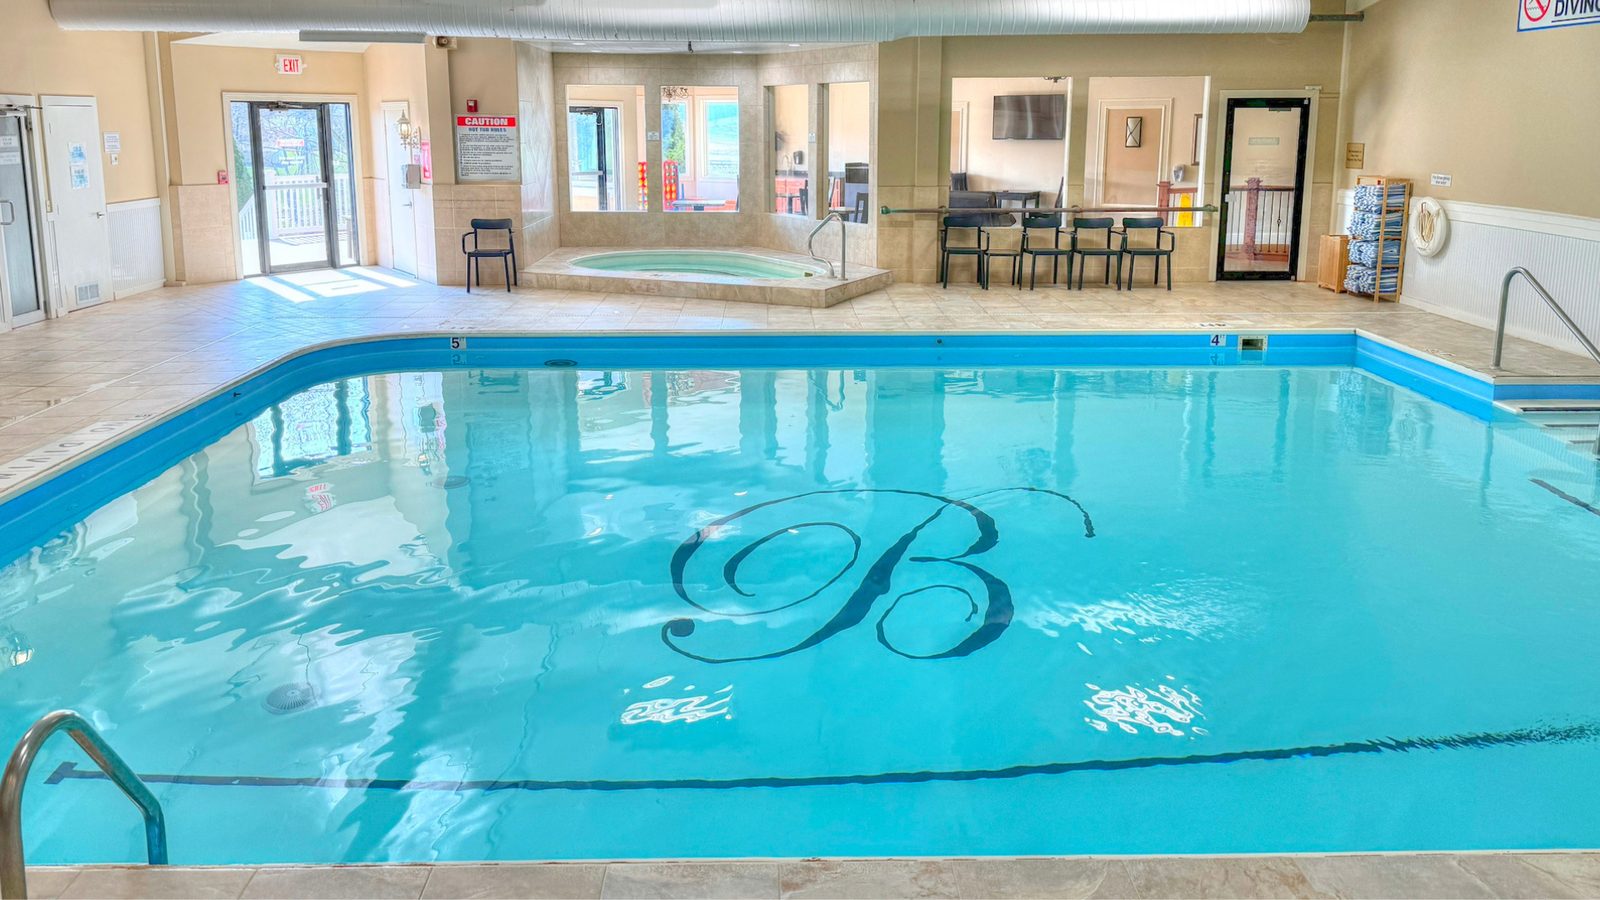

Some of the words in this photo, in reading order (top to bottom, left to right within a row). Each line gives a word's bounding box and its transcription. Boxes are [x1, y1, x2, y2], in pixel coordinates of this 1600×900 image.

[284, 58, 299, 72] EXIT
[465, 117, 508, 126] CAUTION
[452, 337, 460, 349] 5
[1211, 334, 1220, 346] 4
[661, 487, 1095, 664] B
